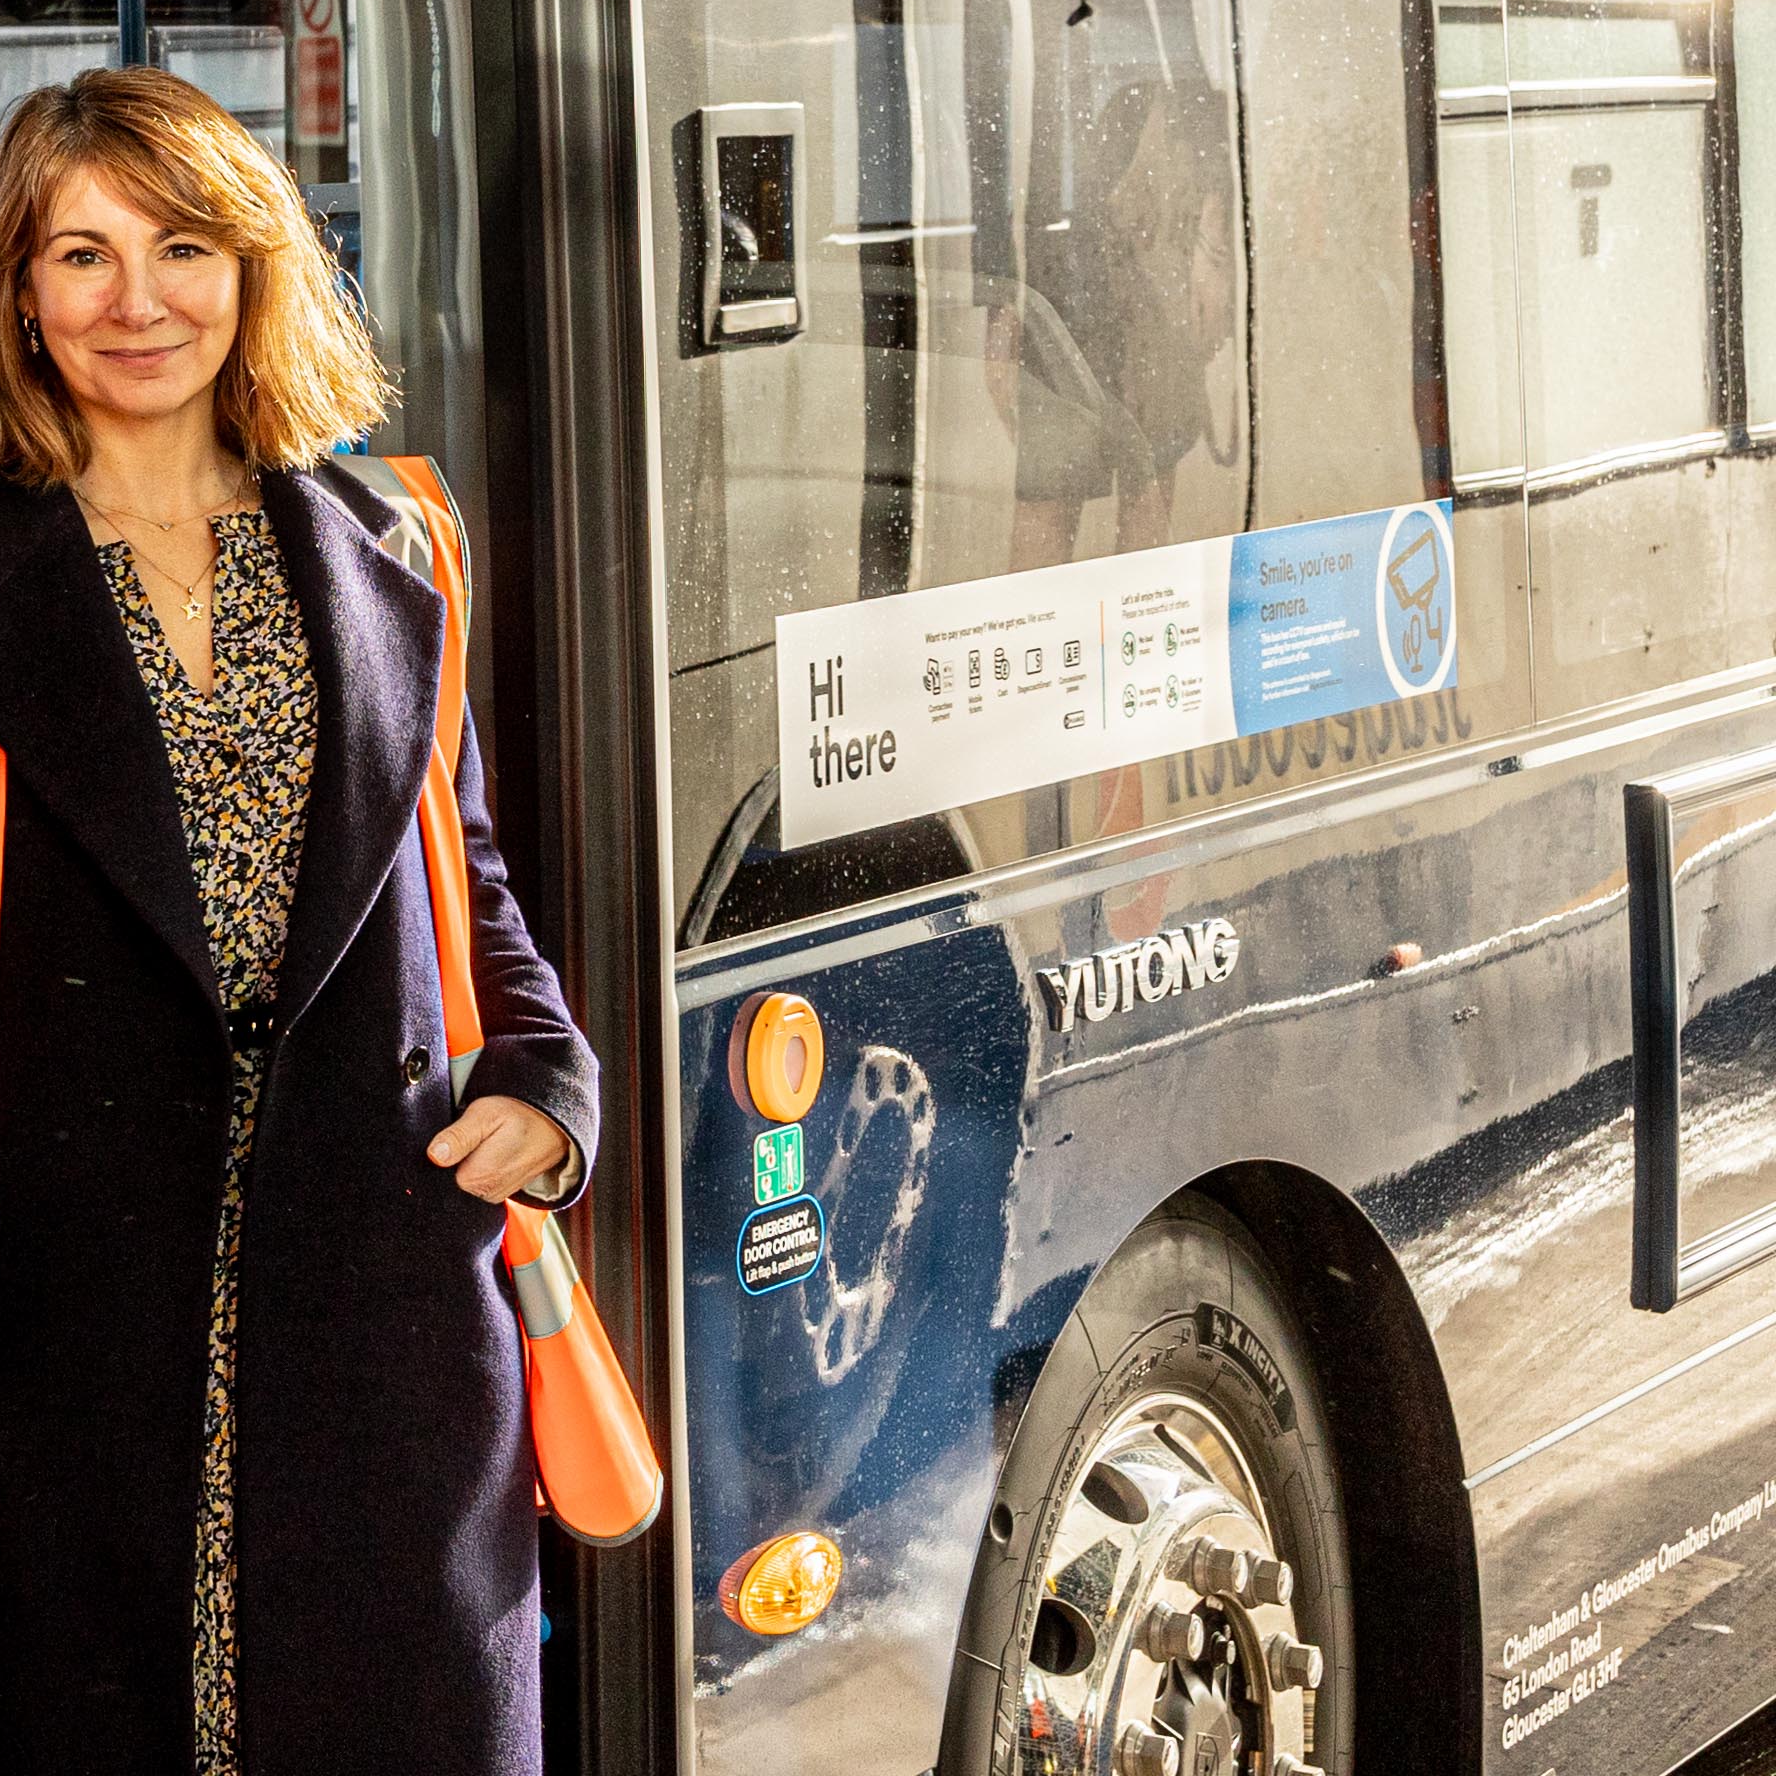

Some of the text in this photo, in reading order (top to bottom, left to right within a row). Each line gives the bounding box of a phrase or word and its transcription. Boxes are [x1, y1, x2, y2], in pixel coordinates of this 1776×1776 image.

[1260, 552, 1353, 586] Smile, you're on
[1260, 597, 1308, 622] camera.
[808, 655, 844, 723] Hi
[808, 725, 898, 791] there
[1036, 917, 1240, 1032] YUTONG
[744, 1226, 819, 1265] DOOR CONTROL
[752, 1208, 809, 1243] EMERGENCY
[1503, 1604, 1580, 1669] Cheltenham
[1580, 1591, 1592, 1619] &
[1592, 1556, 1657, 1614] Gloucester
[1658, 1526, 1709, 1573] Omnibus
[1710, 1488, 1763, 1540] Company
[1502, 1621, 1602, 1710] 65 London Road
[1502, 1647, 1623, 1750] Gloucester GL1 3HF
